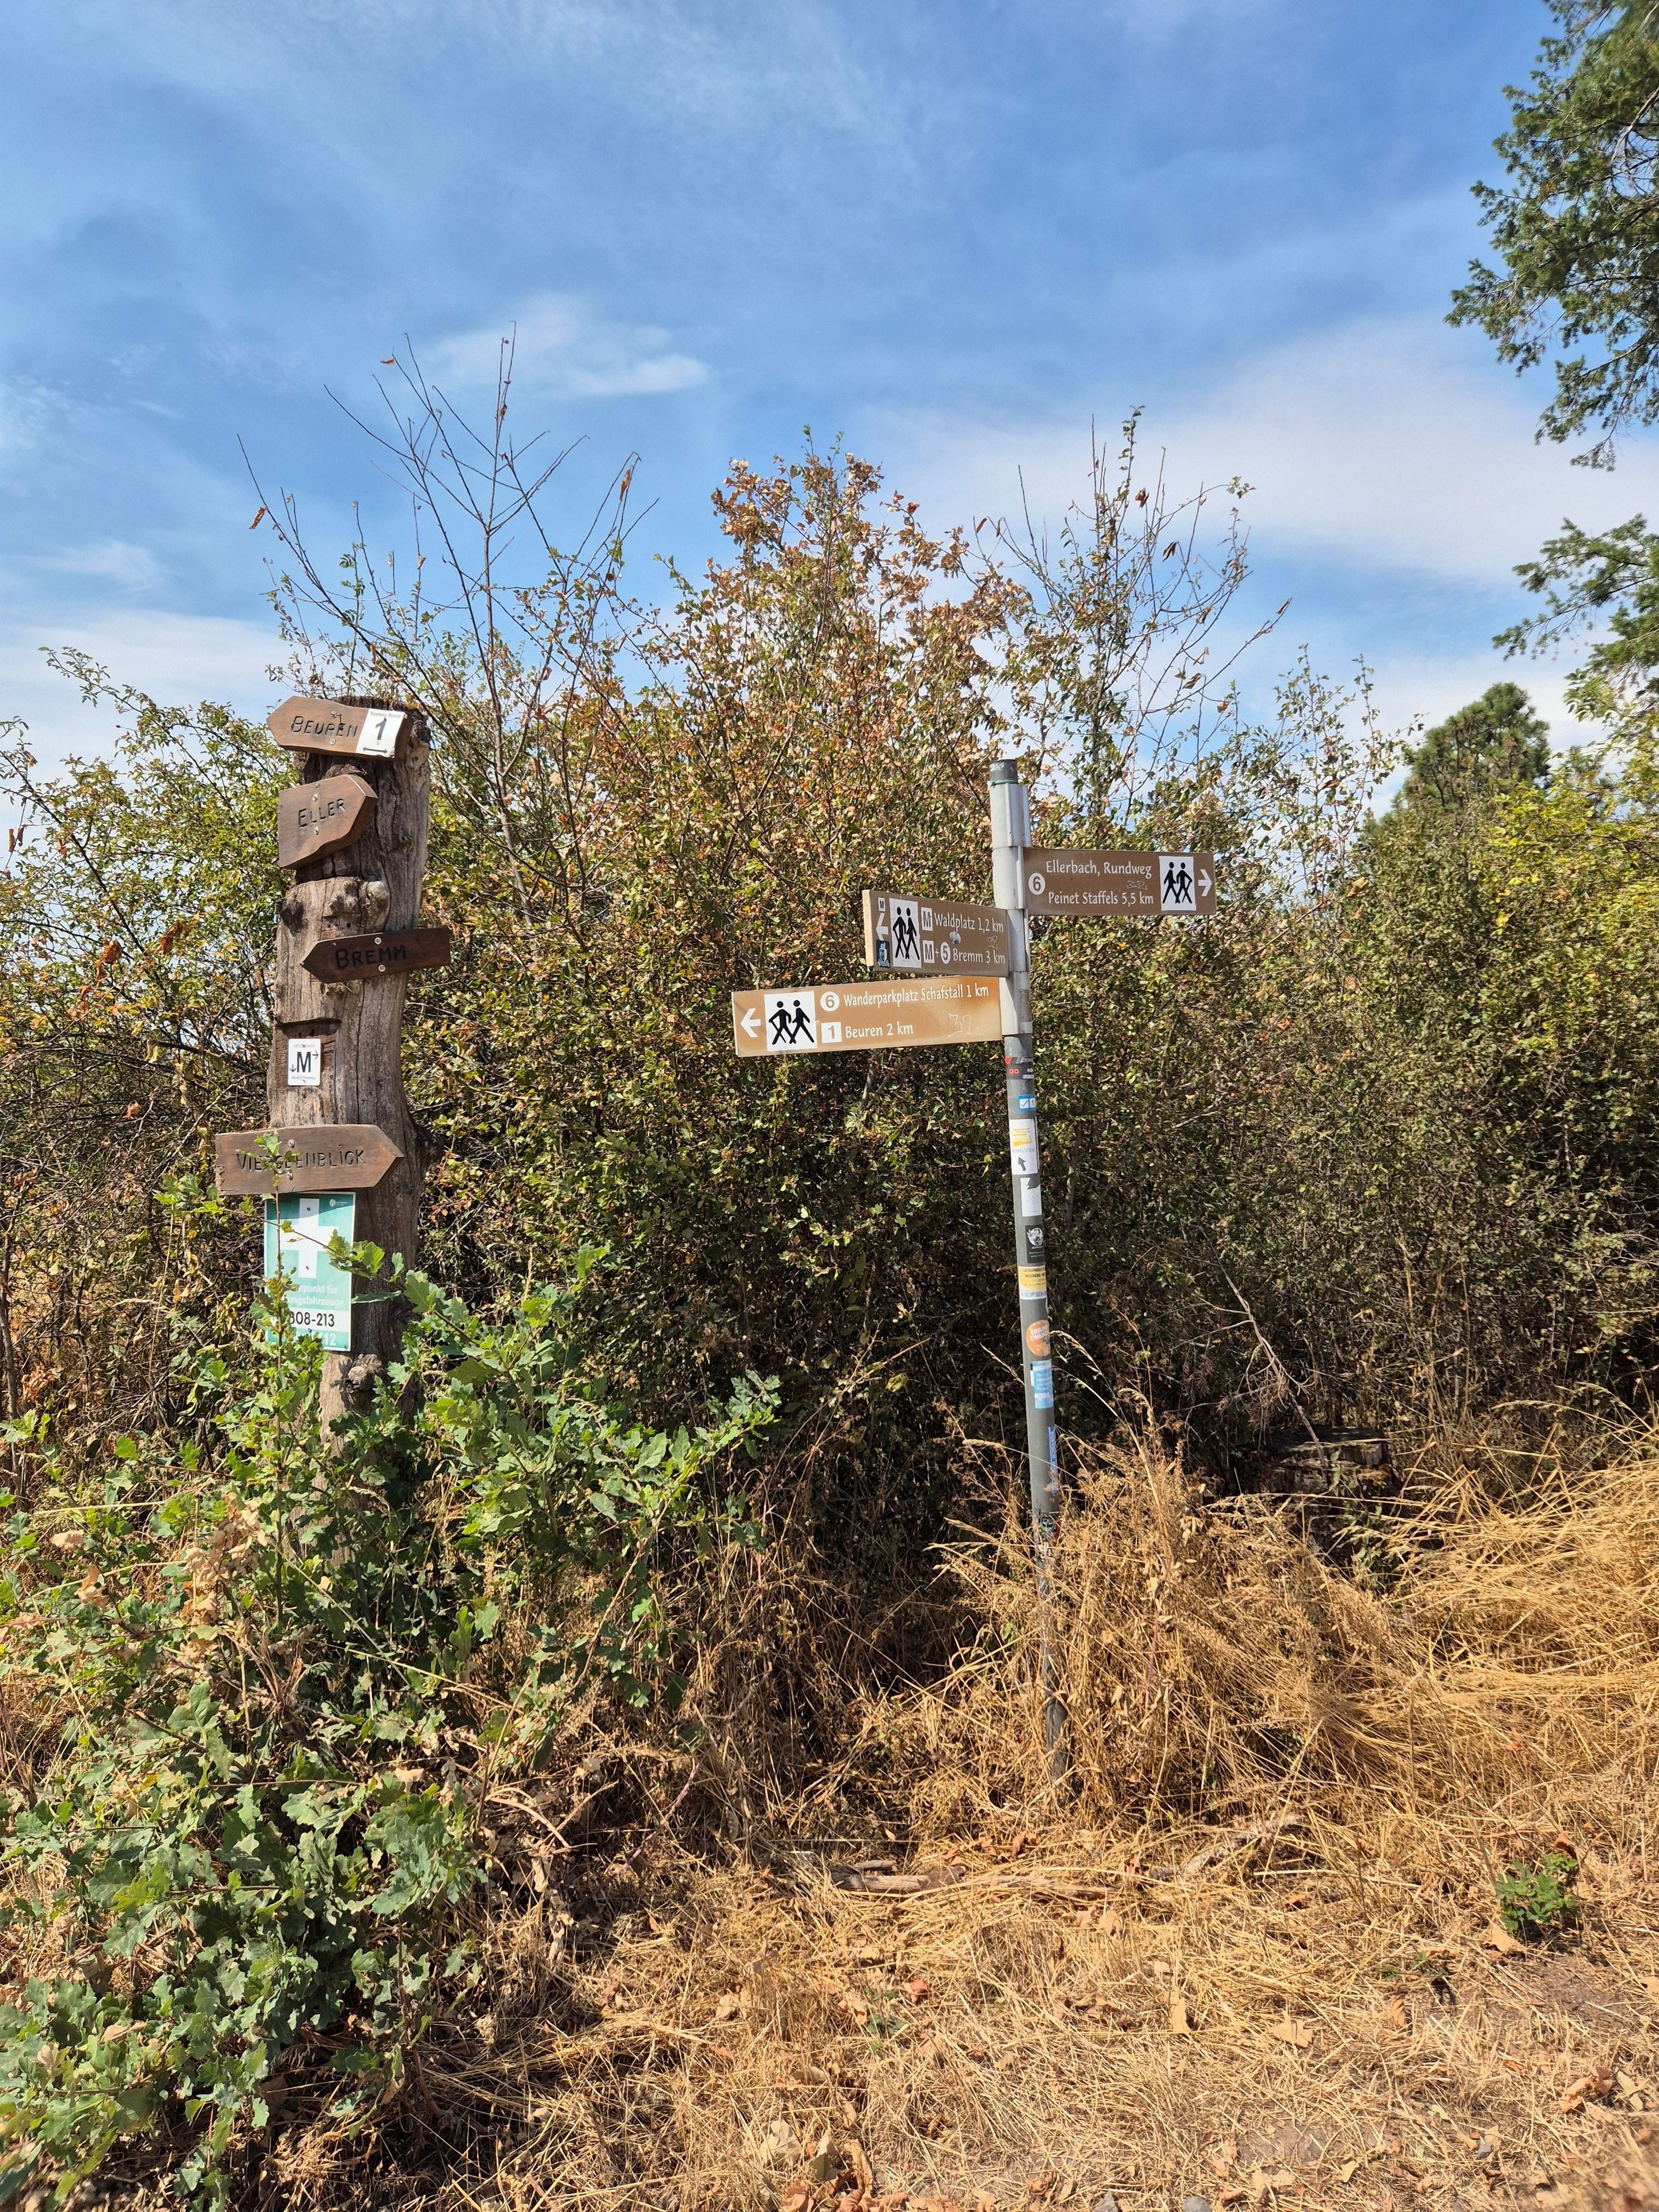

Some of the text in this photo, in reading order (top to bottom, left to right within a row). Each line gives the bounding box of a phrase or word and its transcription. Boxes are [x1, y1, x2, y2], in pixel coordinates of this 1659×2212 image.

[290, 715, 358, 738] BEUREN
[376, 717, 387, 741] 1
[298, 798, 346, 828] ELLER
[1046, 859, 1152, 879] Ellerbach, Rundweg
[1032, 876, 1042, 891] 6
[879, 900, 885, 909] M
[1048, 891, 1154, 907] Peinet Staffels 5,5 km
[923, 911, 1004, 933] M Waldplatz 1,2 km
[335, 945, 407, 969] BREMM
[925, 944, 933, 960] M
[942, 945, 948, 961] 5
[953, 948, 983, 963] Bremm
[986, 950, 991, 964] 3
[994, 950, 1006, 964] km
[825, 983, 989, 1009] 6 Wanderparkplatz Schafstall 1 km
[828, 1021, 914, 1039] 1 Beuren 2 km
[297, 1051, 311, 1073] M
